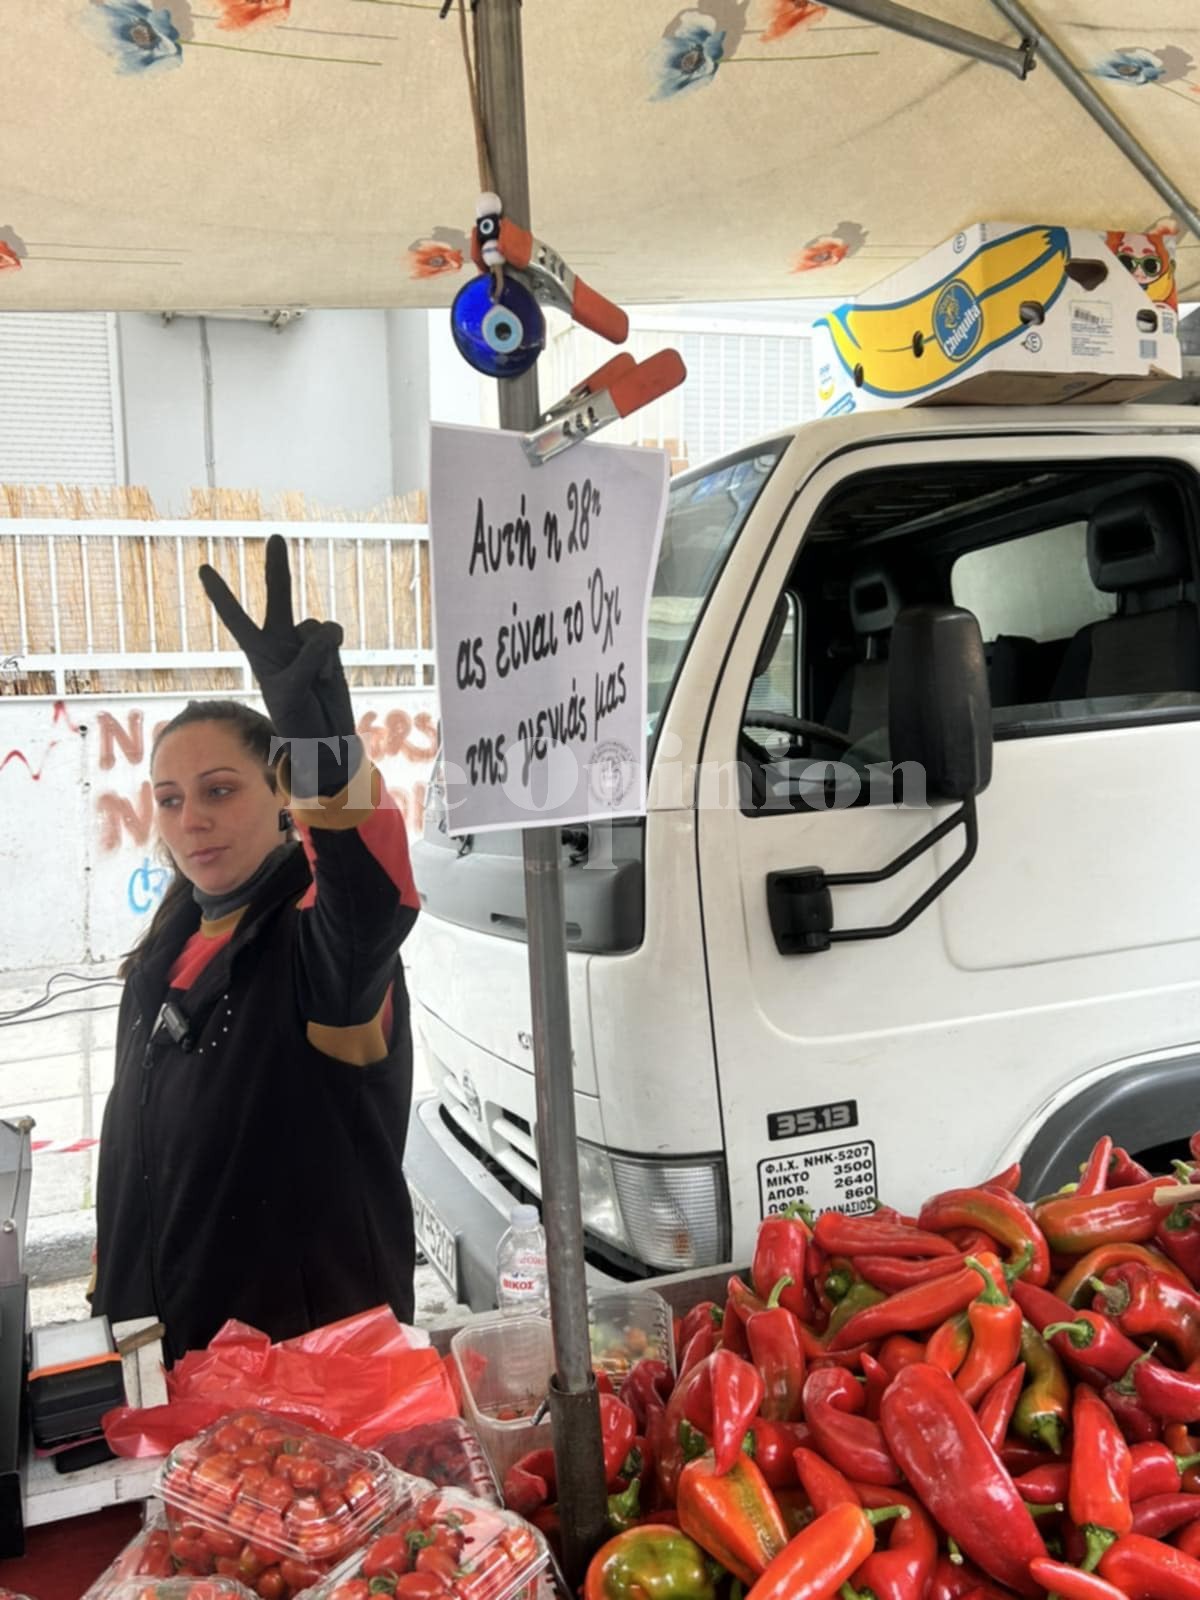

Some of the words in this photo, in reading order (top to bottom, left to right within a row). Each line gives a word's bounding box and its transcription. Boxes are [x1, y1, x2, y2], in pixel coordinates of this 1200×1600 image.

[943, 304, 981, 357] Chiquita
[469, 494, 537, 576] Αυτή
[543, 511, 562, 563] η
[456, 637, 487, 690] ας
[496, 602, 558, 678] είναι
[563, 600, 584, 645] το
[466, 734, 508, 786] της
[518, 678, 588, 787] γενιάς
[595, 662, 627, 742] μας
[777, 1105, 851, 1136] 35.13
[767, 1185, 809, 1201] ΑΠΟΒ.
[834, 1172, 873, 1188] 2640
[833, 1159, 873, 1175] 3500
[844, 1185, 874, 1200] 860
